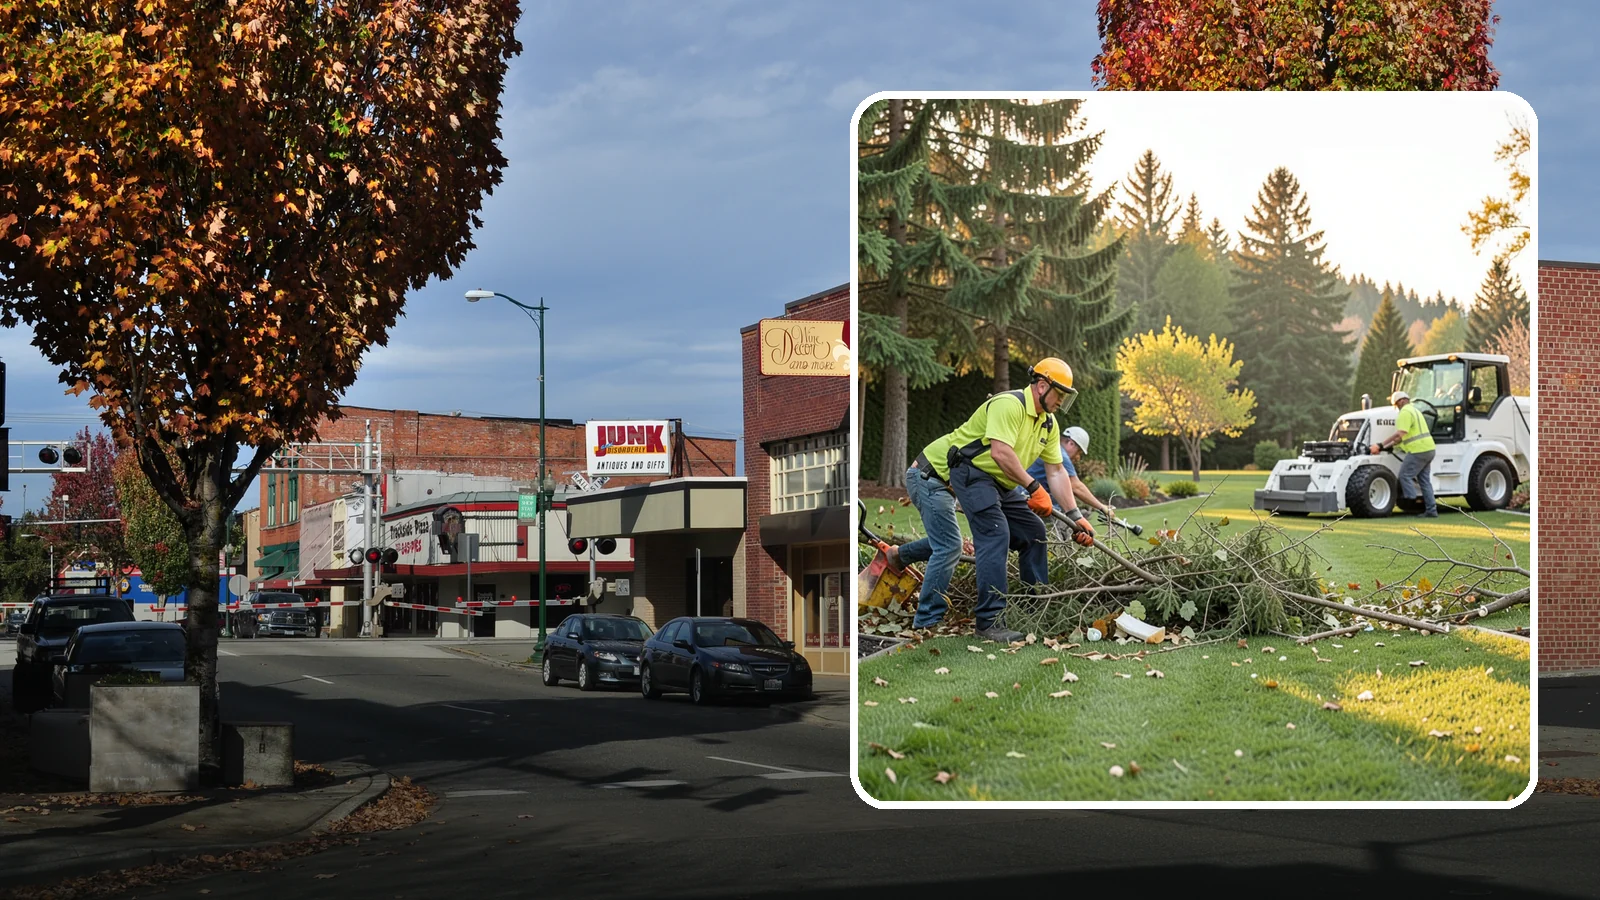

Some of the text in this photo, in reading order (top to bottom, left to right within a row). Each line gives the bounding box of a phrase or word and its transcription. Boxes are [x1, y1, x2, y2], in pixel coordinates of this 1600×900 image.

[595, 426, 665, 457] JUNK
[607, 446, 646, 454] DISORDERLY
[596, 460, 665, 470] ANTIQUES AND GIFTS
[414, 520, 429, 535] Pizza
